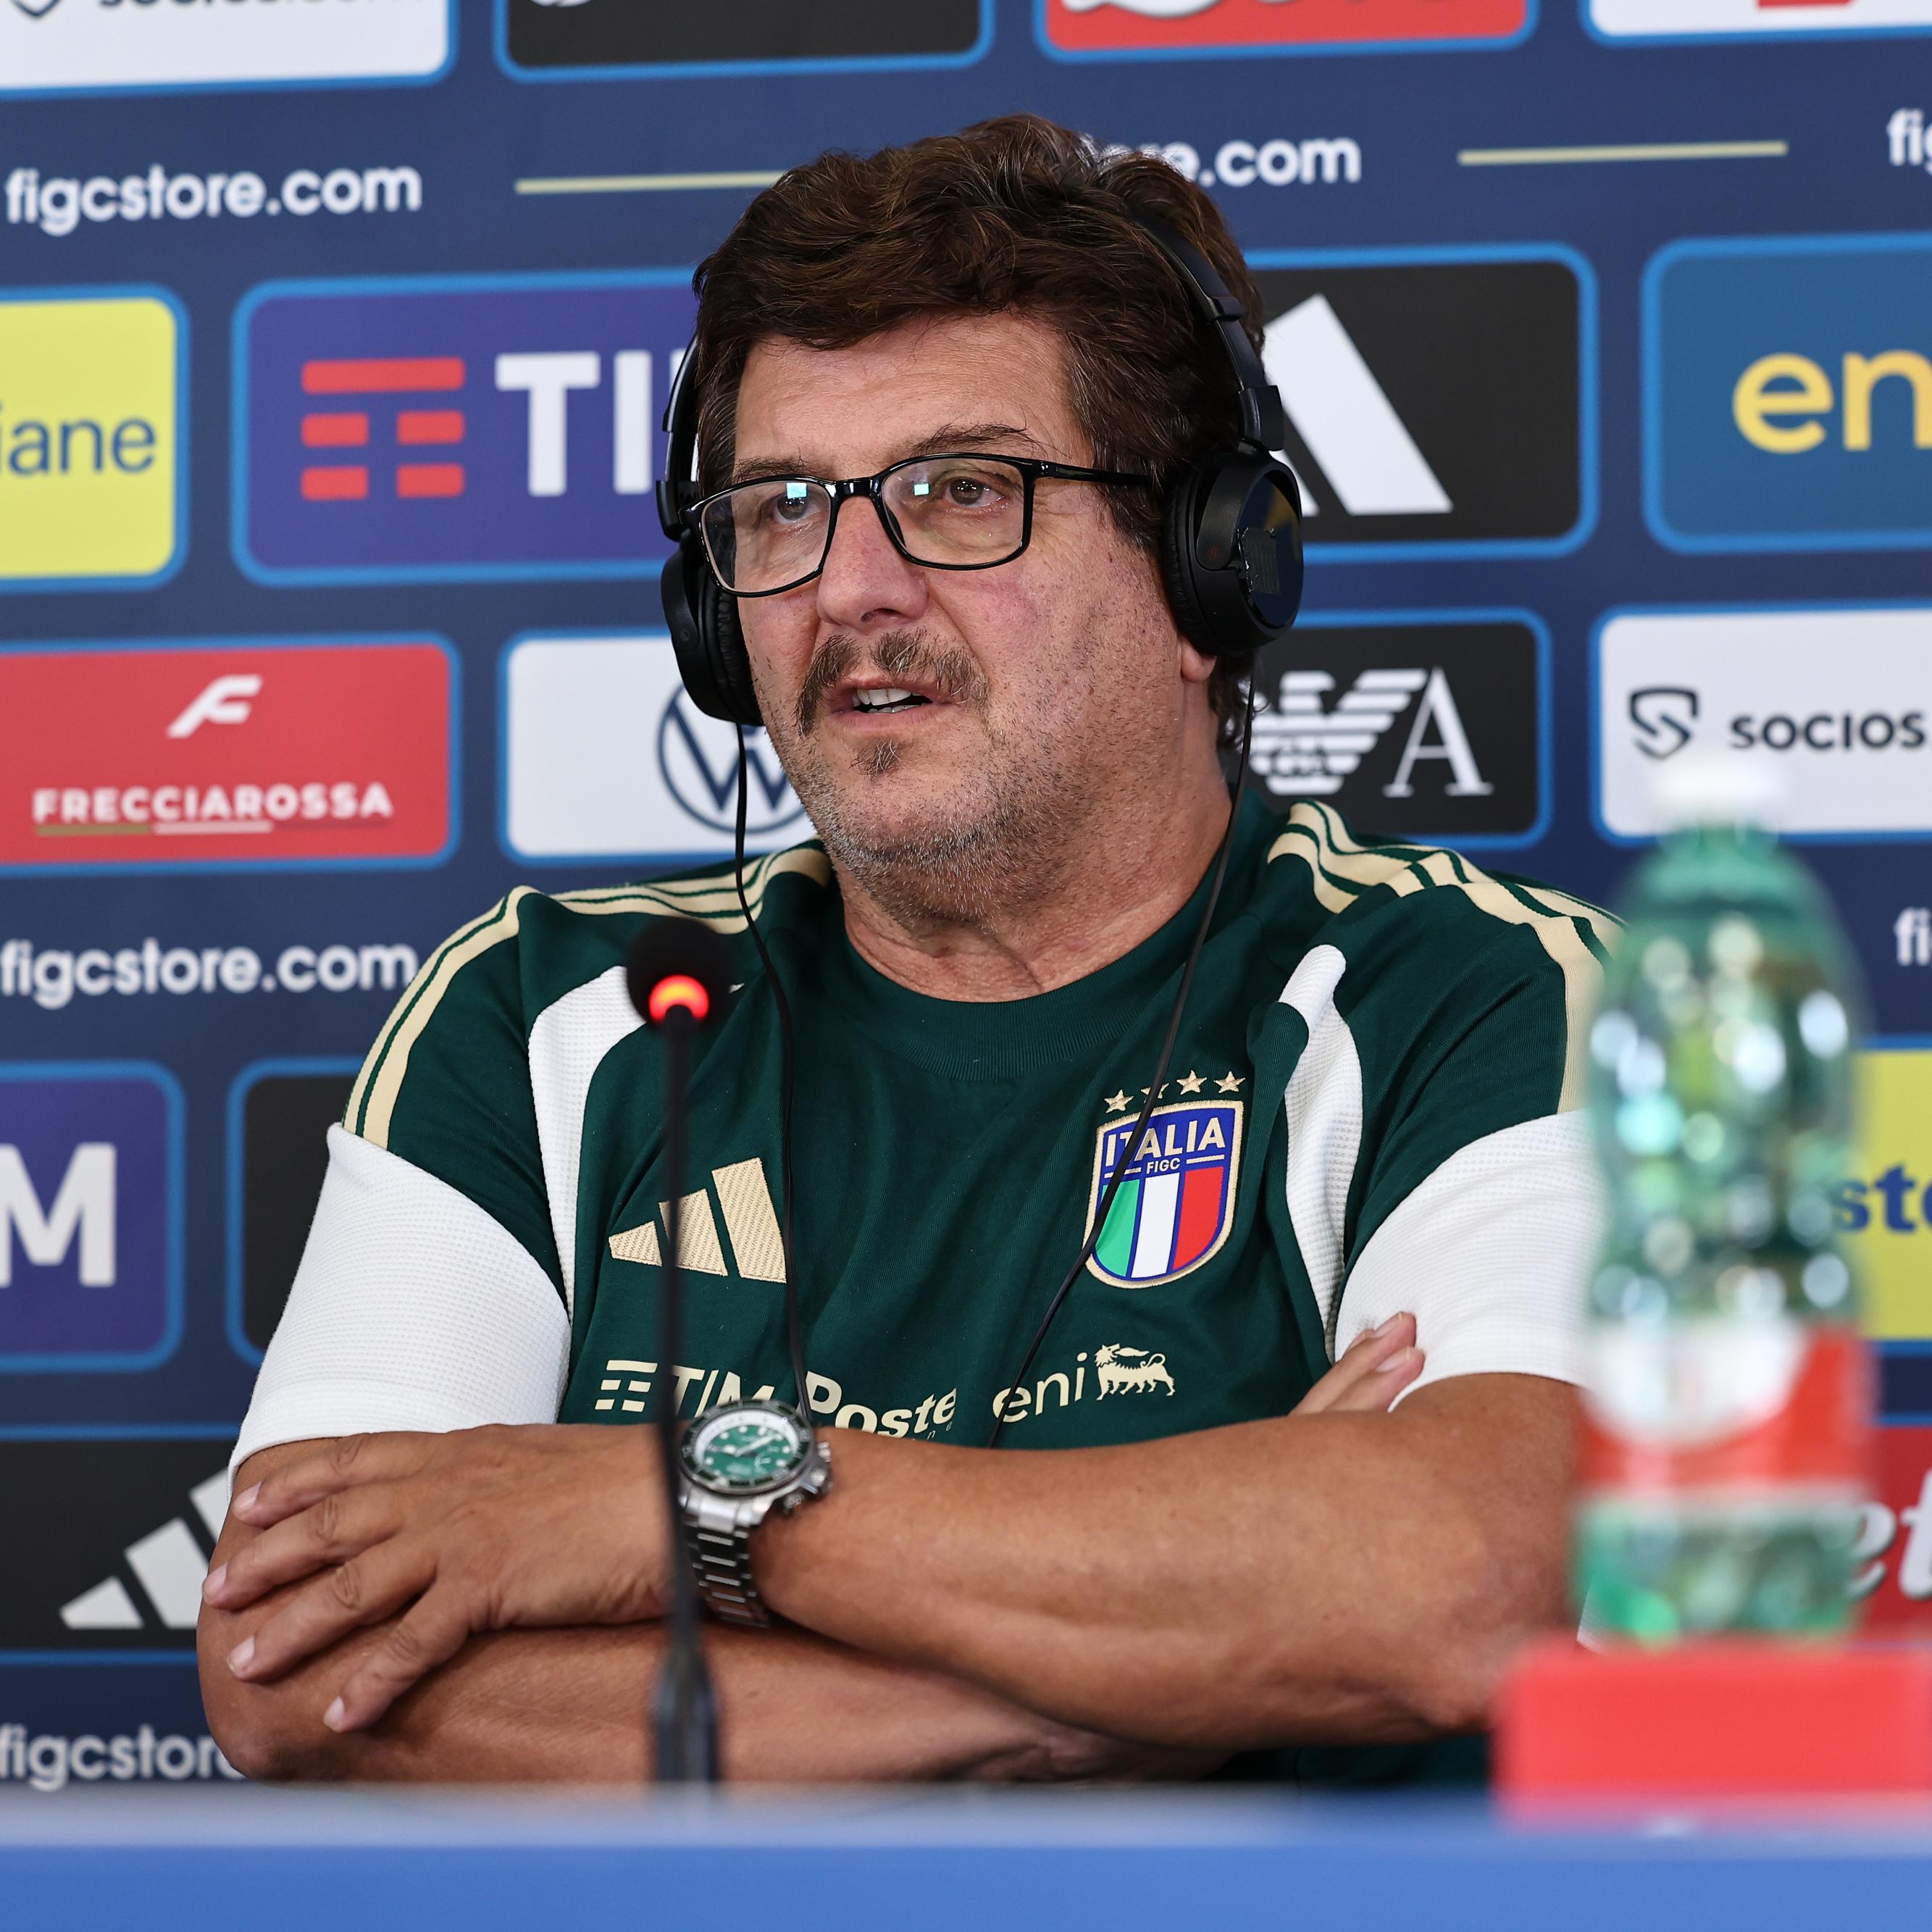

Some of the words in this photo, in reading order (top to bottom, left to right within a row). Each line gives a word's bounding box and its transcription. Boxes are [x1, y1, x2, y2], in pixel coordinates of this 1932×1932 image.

[1097, 136, 1362, 188] e.com
[1886, 108, 1932, 175] fi
[5, 164, 422, 235] figcstore.com
[495, 348, 687, 497] TI
[1733, 350, 1932, 454] en
[0, 402, 156, 477] ane
[1730, 711, 1925, 751] SOCIOS
[33, 782, 394, 824] FRECCIAROSSA
[0, 940, 417, 1009] figcstore.com
[1105, 1117, 1226, 1167] ITALIA
[1146, 1158, 1181, 1174] FIGC
[1831, 1166, 1932, 1232] st
[797, 1371, 957, 1439] Poste
[992, 1352, 1087, 1423] eni
